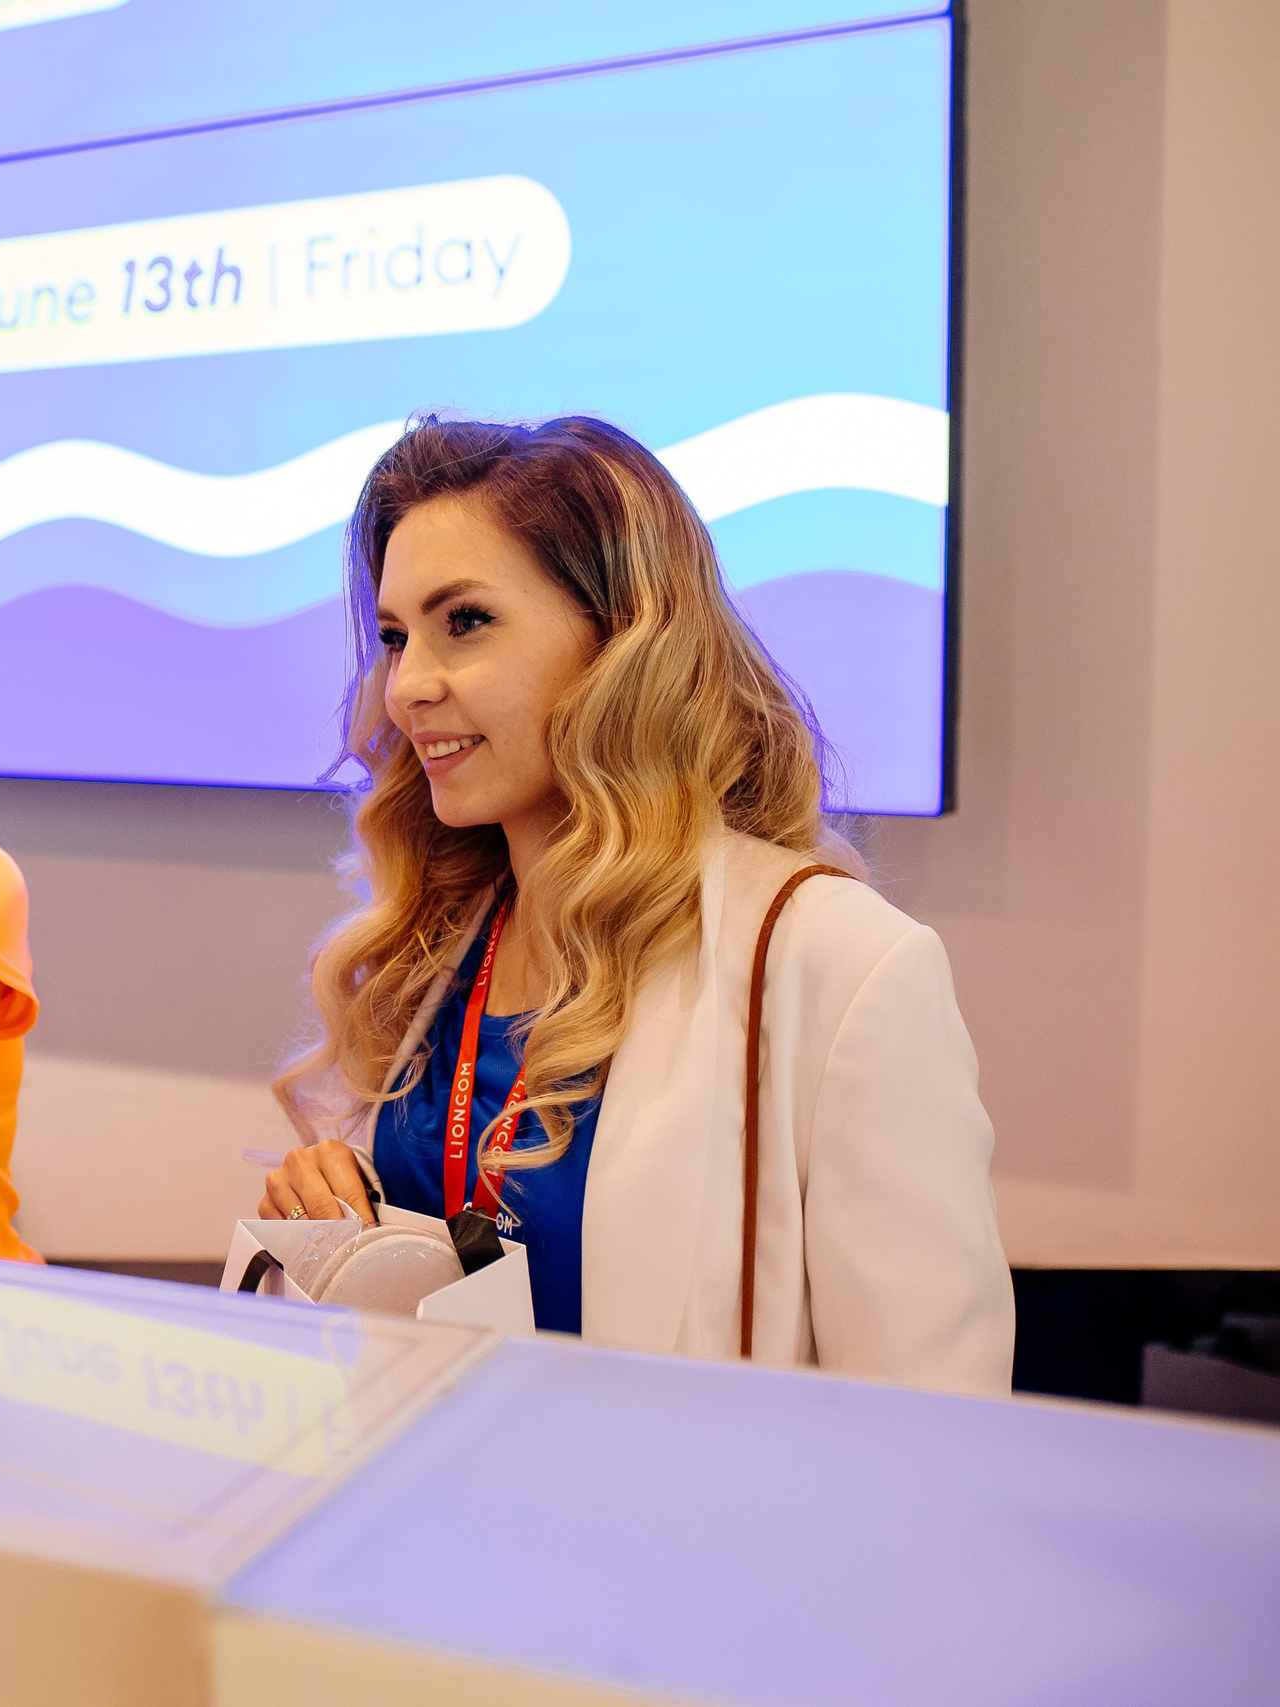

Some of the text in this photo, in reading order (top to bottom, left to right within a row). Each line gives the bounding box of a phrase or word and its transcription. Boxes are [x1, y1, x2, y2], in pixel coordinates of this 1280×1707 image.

[120, 243, 244, 315] 13th
[306, 221, 522, 298] Friday
[450, 1062, 472, 1159] LIONCOM
